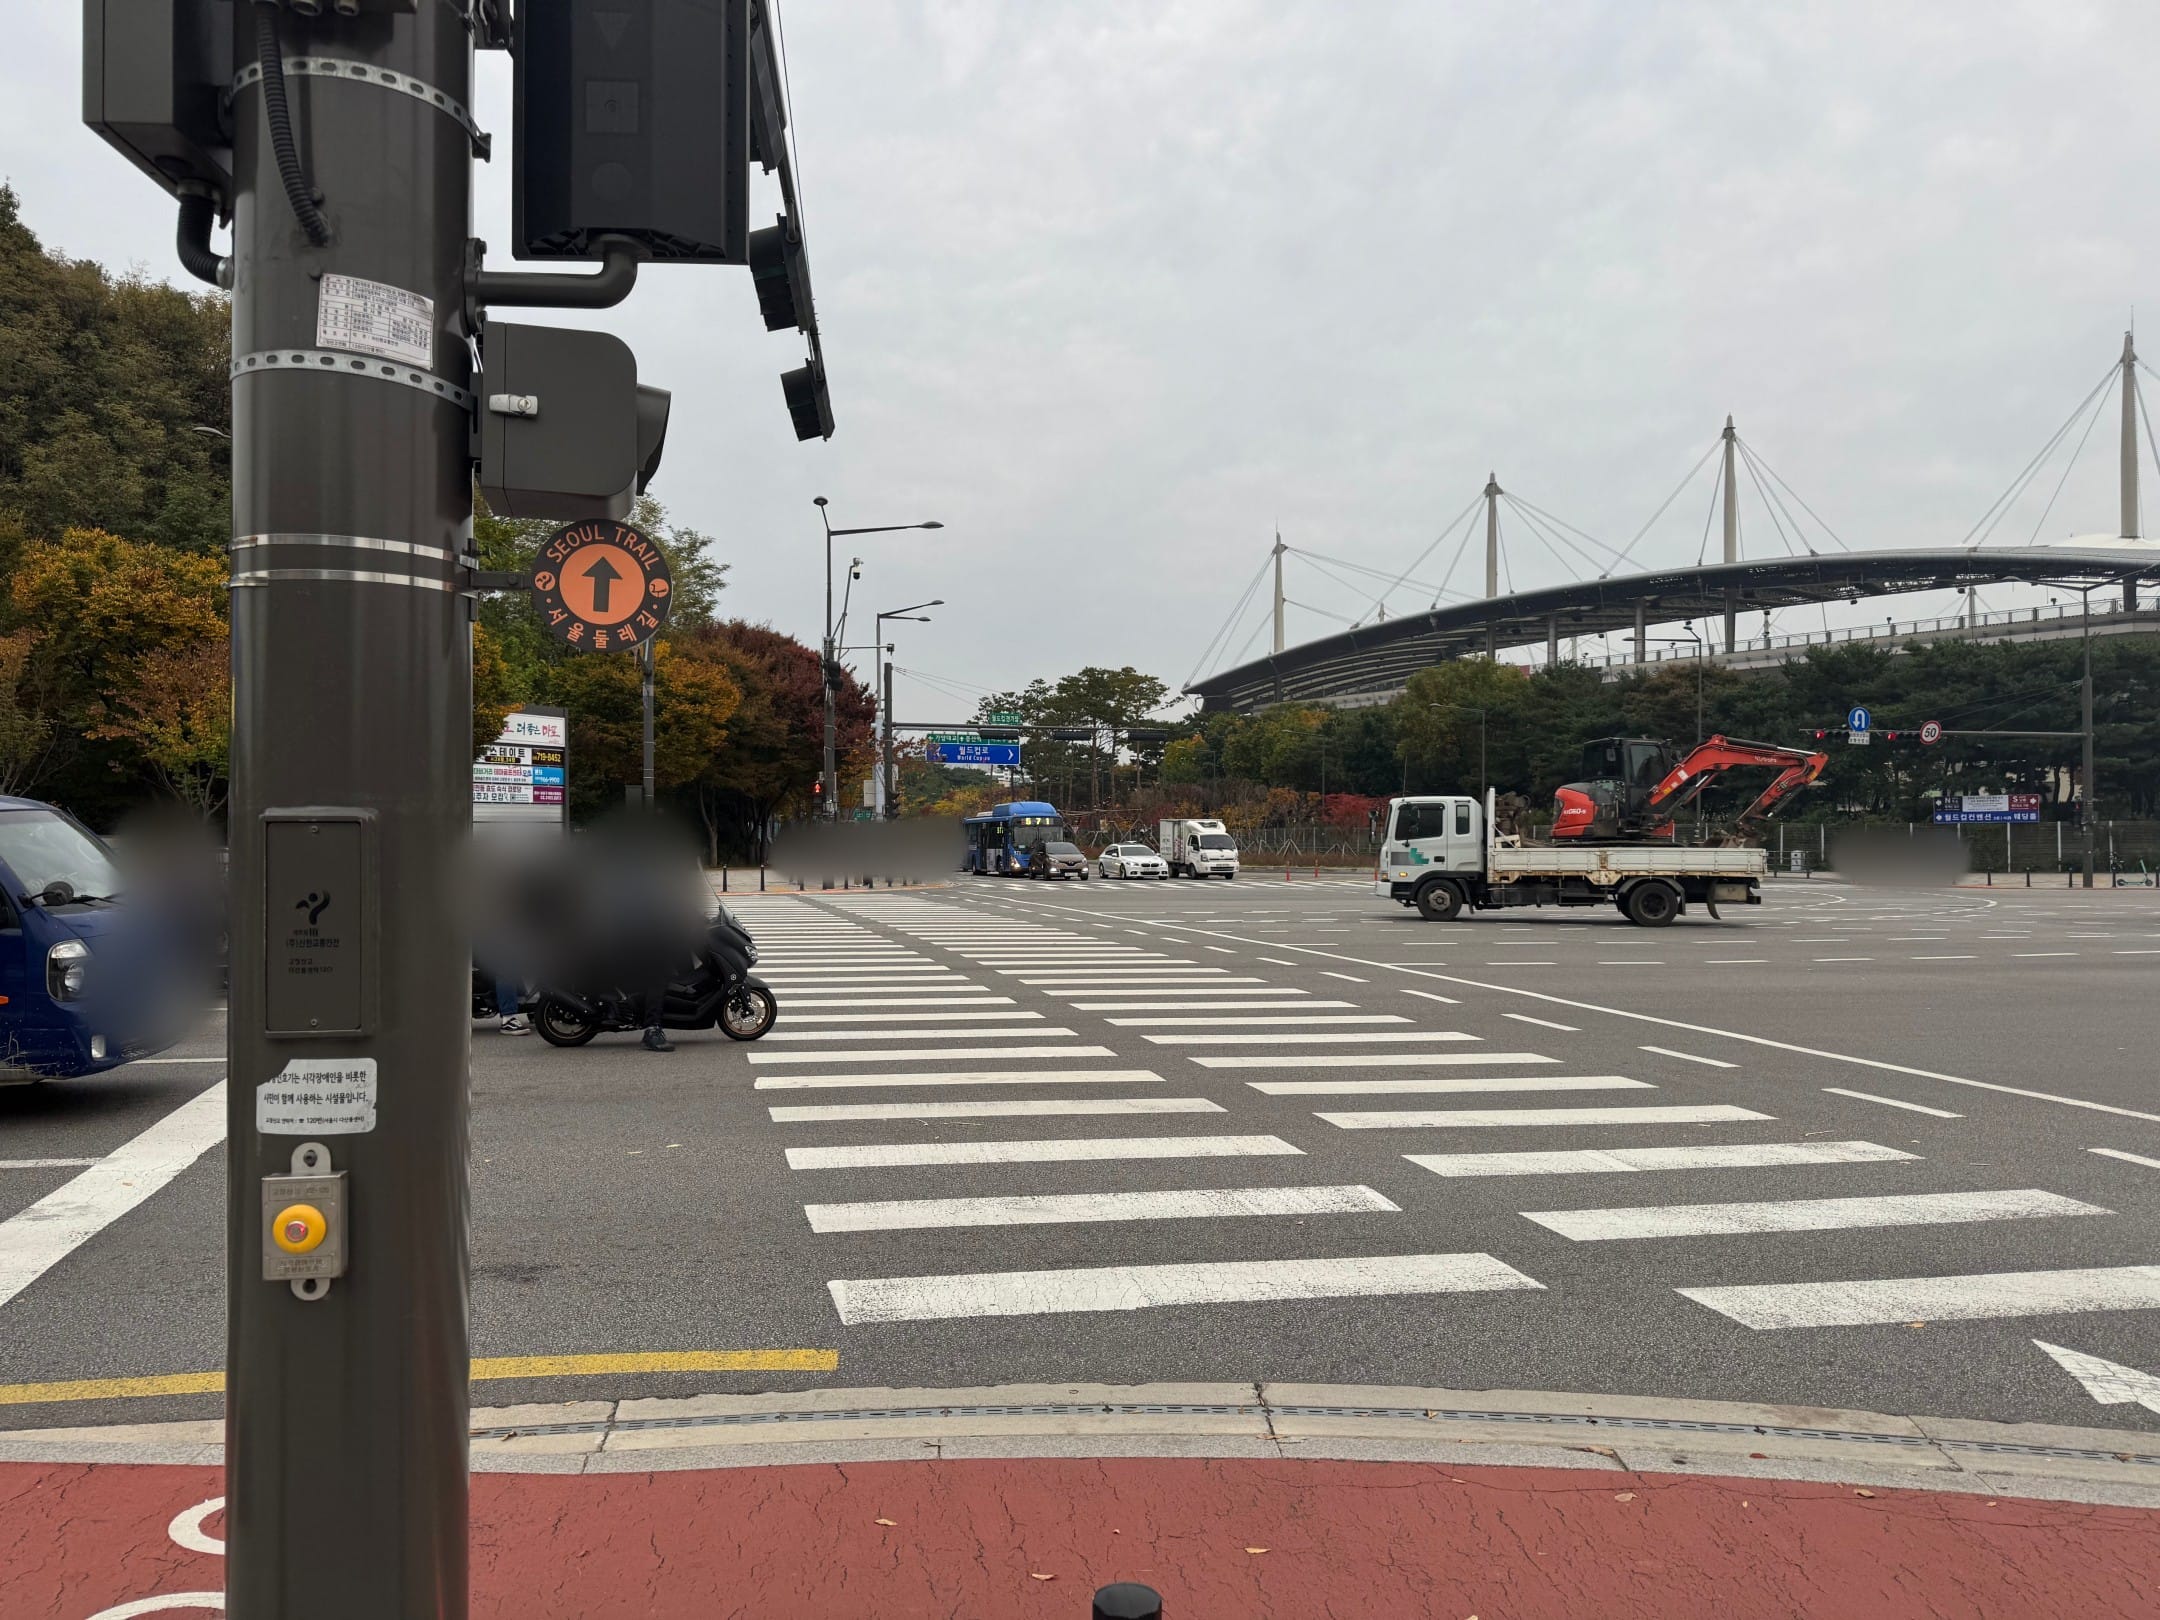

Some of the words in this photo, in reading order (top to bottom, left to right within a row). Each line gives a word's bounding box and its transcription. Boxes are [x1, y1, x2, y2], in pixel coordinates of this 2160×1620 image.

[546, 525, 604, 563] SEOUL
[615, 526, 660, 571] TRAIL
[548, 608, 659, 648] 서울둘레길
[542, 724, 560, 738] 마포
[1924, 727, 1937, 738] 50
[959, 745, 989, 756] 월드컵로
[1944, 813, 1992, 821] 월드컵컨벤션
[271, 1072, 301, 1084] 신호기는
[302, 1071, 344, 1084] 시각장애인을
[345, 1070, 367, 1083] 비롯한
[280, 1093, 294, 1105] 함께
[296, 1093, 323, 1105] 사용하는
[325, 1091, 369, 1104] 시설물입니다.
